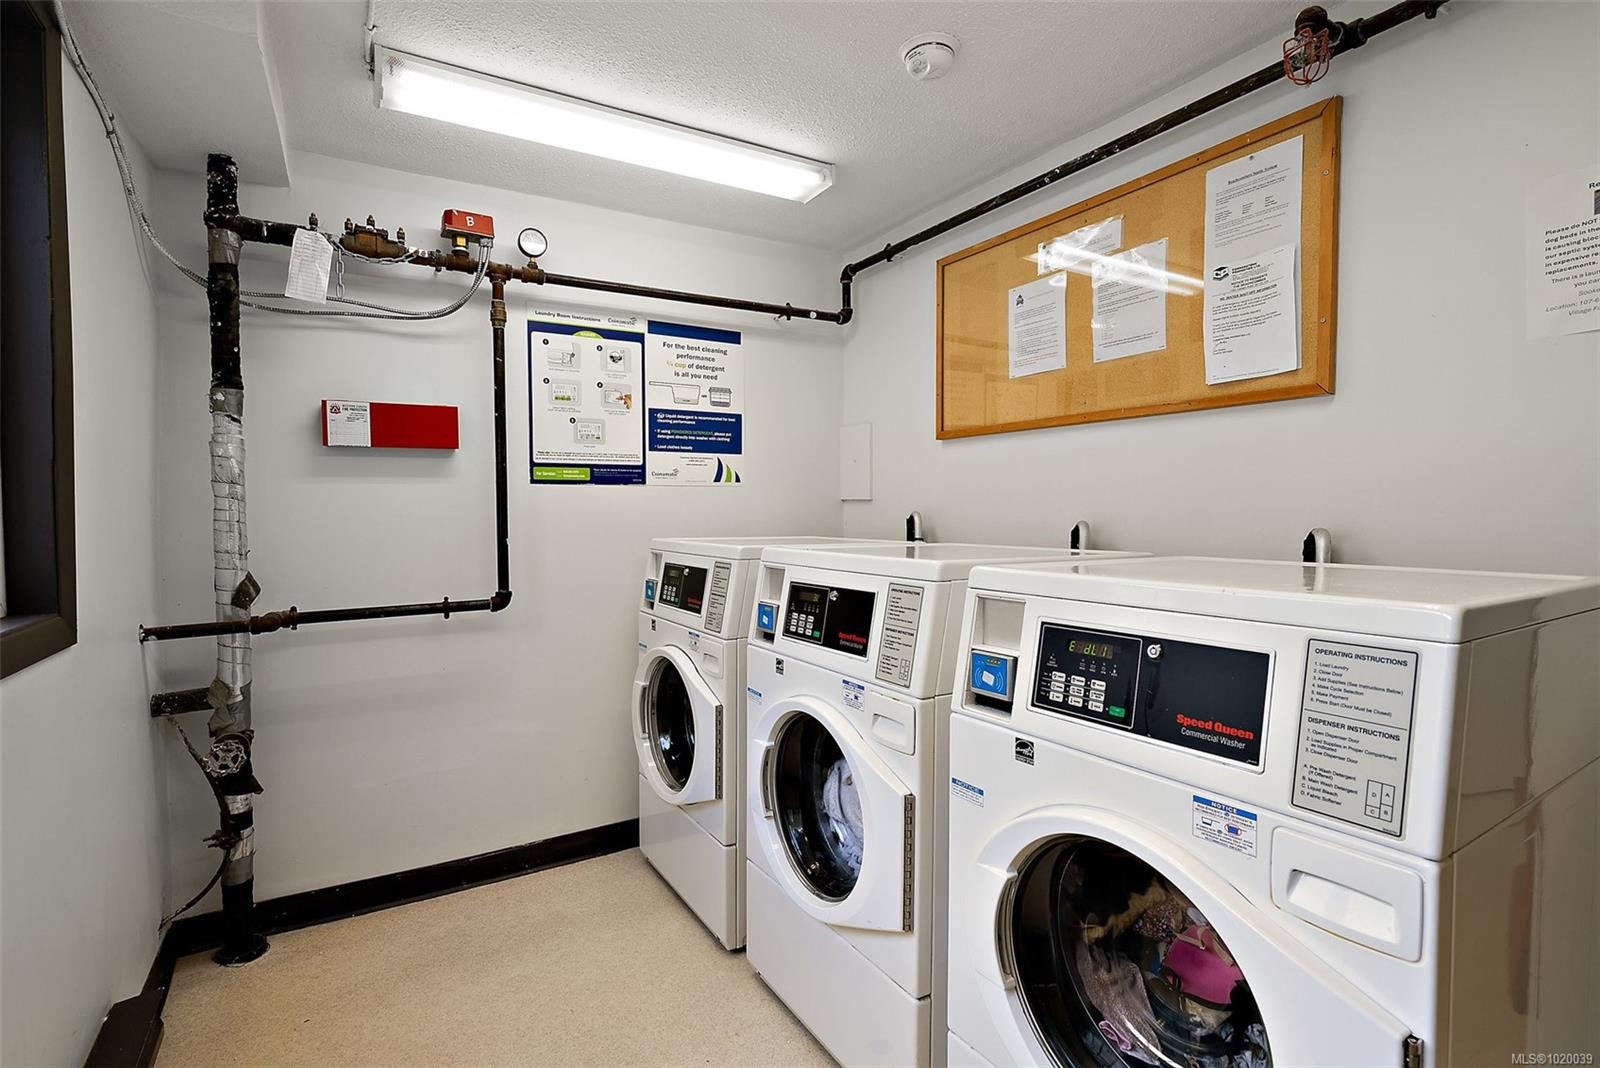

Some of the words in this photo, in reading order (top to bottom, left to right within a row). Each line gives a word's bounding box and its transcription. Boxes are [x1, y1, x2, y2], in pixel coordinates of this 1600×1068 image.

[466, 216, 474, 226] B
[1545, 226, 1569, 236] Please
[1582, 218, 1598, 226] NOT
[1553, 240, 1581, 250] causing
[1559, 248, 1581, 256] septic
[1554, 254, 1590, 265] expensive
[1545, 261, 1598, 275] replacements.
[572, 314, 601, 322] Instructions
[702, 347, 727, 355] cleaning
[676, 353, 715, 362] performance
[695, 364, 725, 372] detergent
[1315, 648, 1353, 659] OPERATING
[1355, 653, 1408, 666] INSTRUCTIONS
[1328, 678, 1346, 686] Supplies
[1359, 683, 1385, 692] Instructions
[1373, 709, 1392, 717] Closed)
[1176, 714, 1213, 730] Speed
[1214, 722, 1254, 739] Queen
[1308, 717, 1345, 730] DISPENSER
[1347, 724, 1400, 741] INSTRUCTIONS
[1181, 727, 1219, 742] Commercial
[1220, 736, 1246, 749] Washer
[1325, 732, 1347, 741] Dispenser
[1317, 744, 1337, 752] Indicated
[1323, 739, 1342, 748] Supplies
[1348, 745, 1364, 754] Proper
[1365, 749, 1397, 761] Compartment
[1323, 751, 1346, 761] Dispenser
[1314, 772, 1333, 781] Offered)
[1333, 770, 1356, 781] Detergent
[1322, 788, 1338, 797] Bleach
[1334, 782, 1358, 794] Detergent
[1322, 796, 1342, 805] Softener
[1211, 802, 1237, 813] NOTICE
